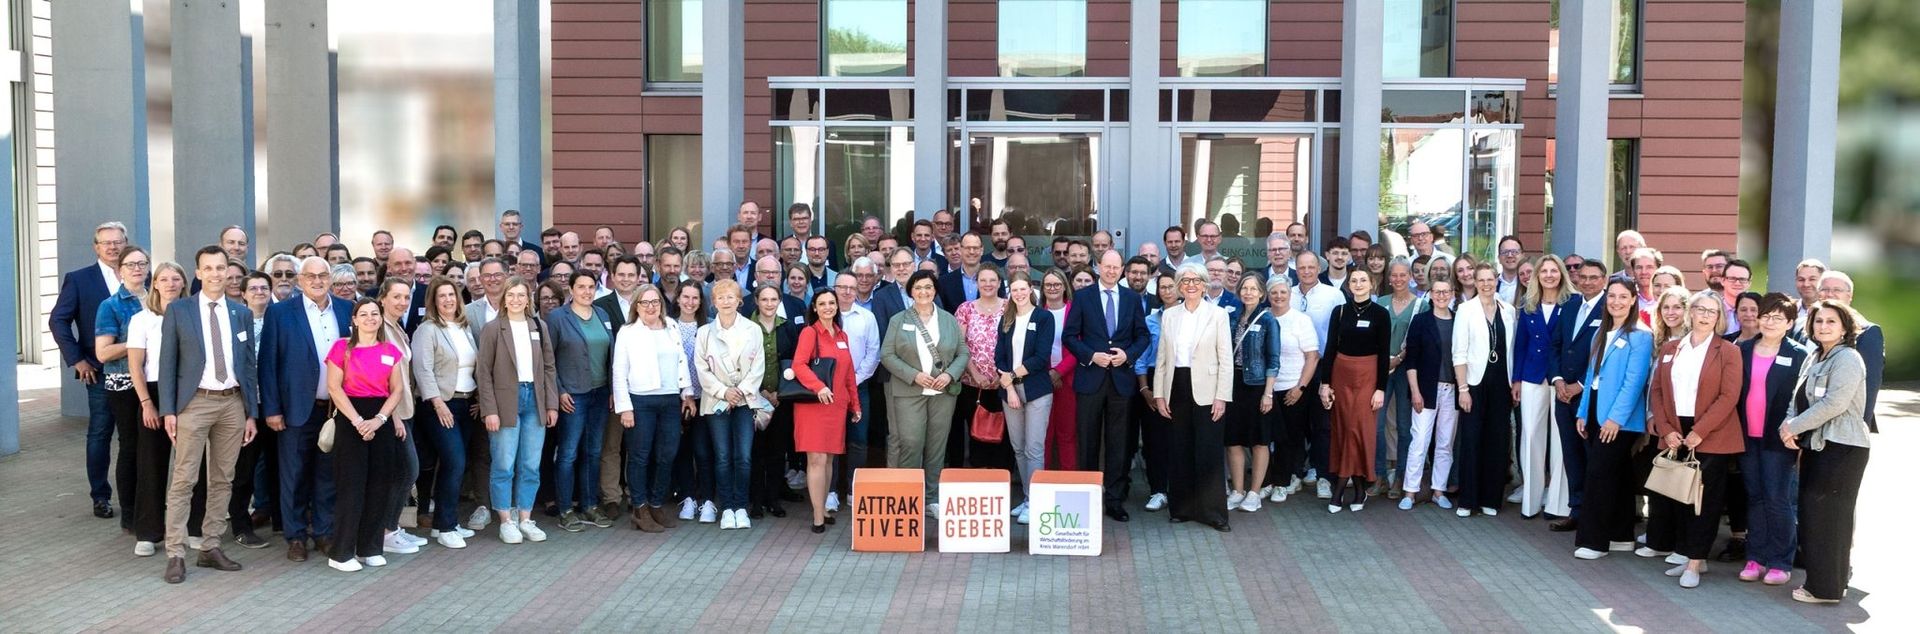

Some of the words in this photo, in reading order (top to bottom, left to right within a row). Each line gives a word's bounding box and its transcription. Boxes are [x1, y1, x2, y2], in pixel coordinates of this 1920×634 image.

[1221, 247, 1267, 257] EINGANG
[857, 495, 919, 515] ATTRAK
[945, 496, 1004, 516] ARBEIT
[856, 518, 919, 537] TIVER
[945, 519, 1004, 538] GEBER
